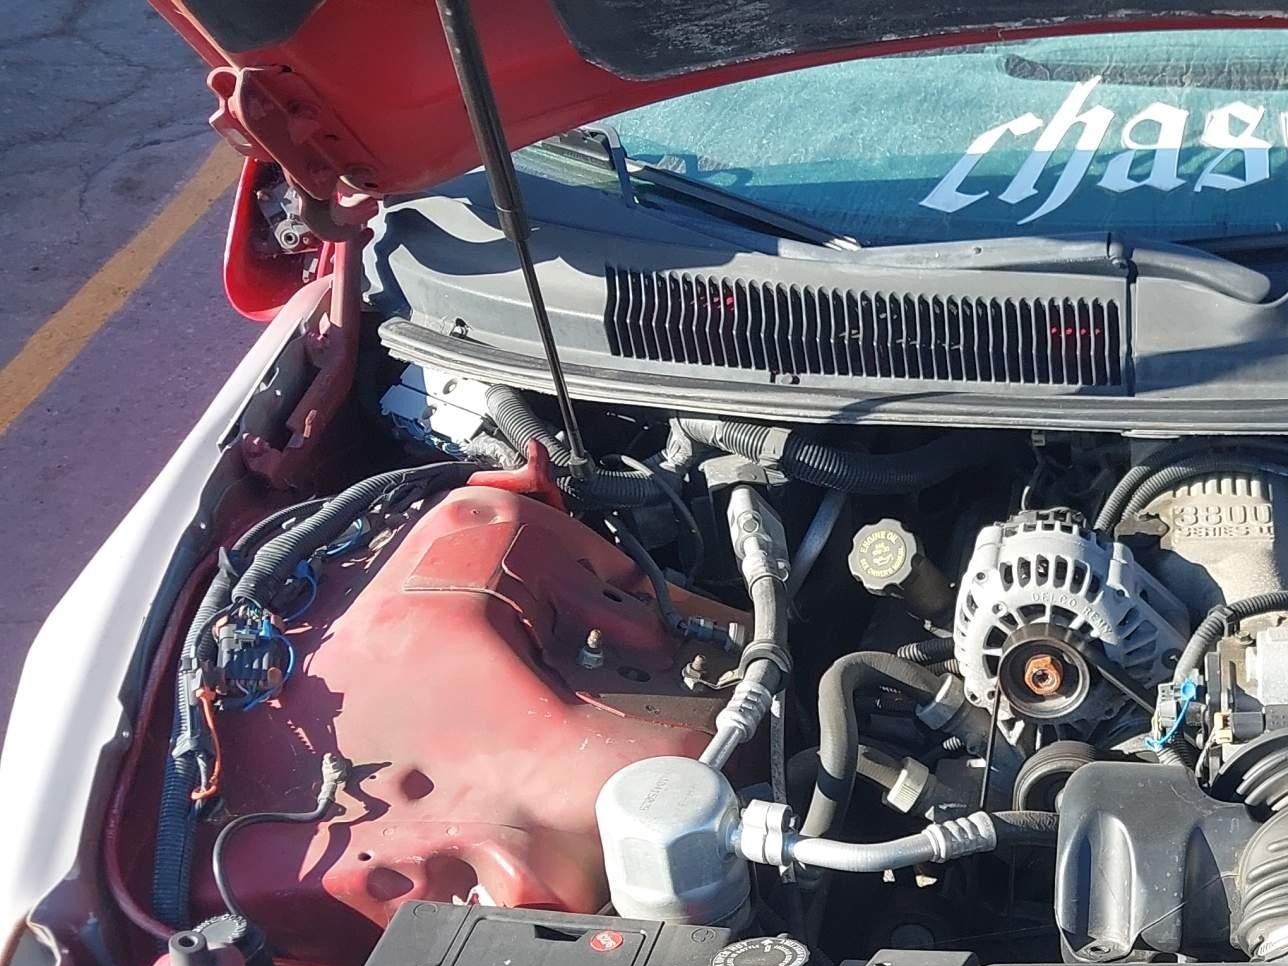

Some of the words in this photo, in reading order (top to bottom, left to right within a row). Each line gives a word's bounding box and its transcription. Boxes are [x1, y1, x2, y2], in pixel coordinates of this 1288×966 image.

[1175, 504, 1273, 526] 3800
[861, 531, 886, 553] ENGINE
[887, 532, 899, 544] OIL
[1033, 592, 1077, 607] DELCO
[1083, 607, 1112, 633] REMY
